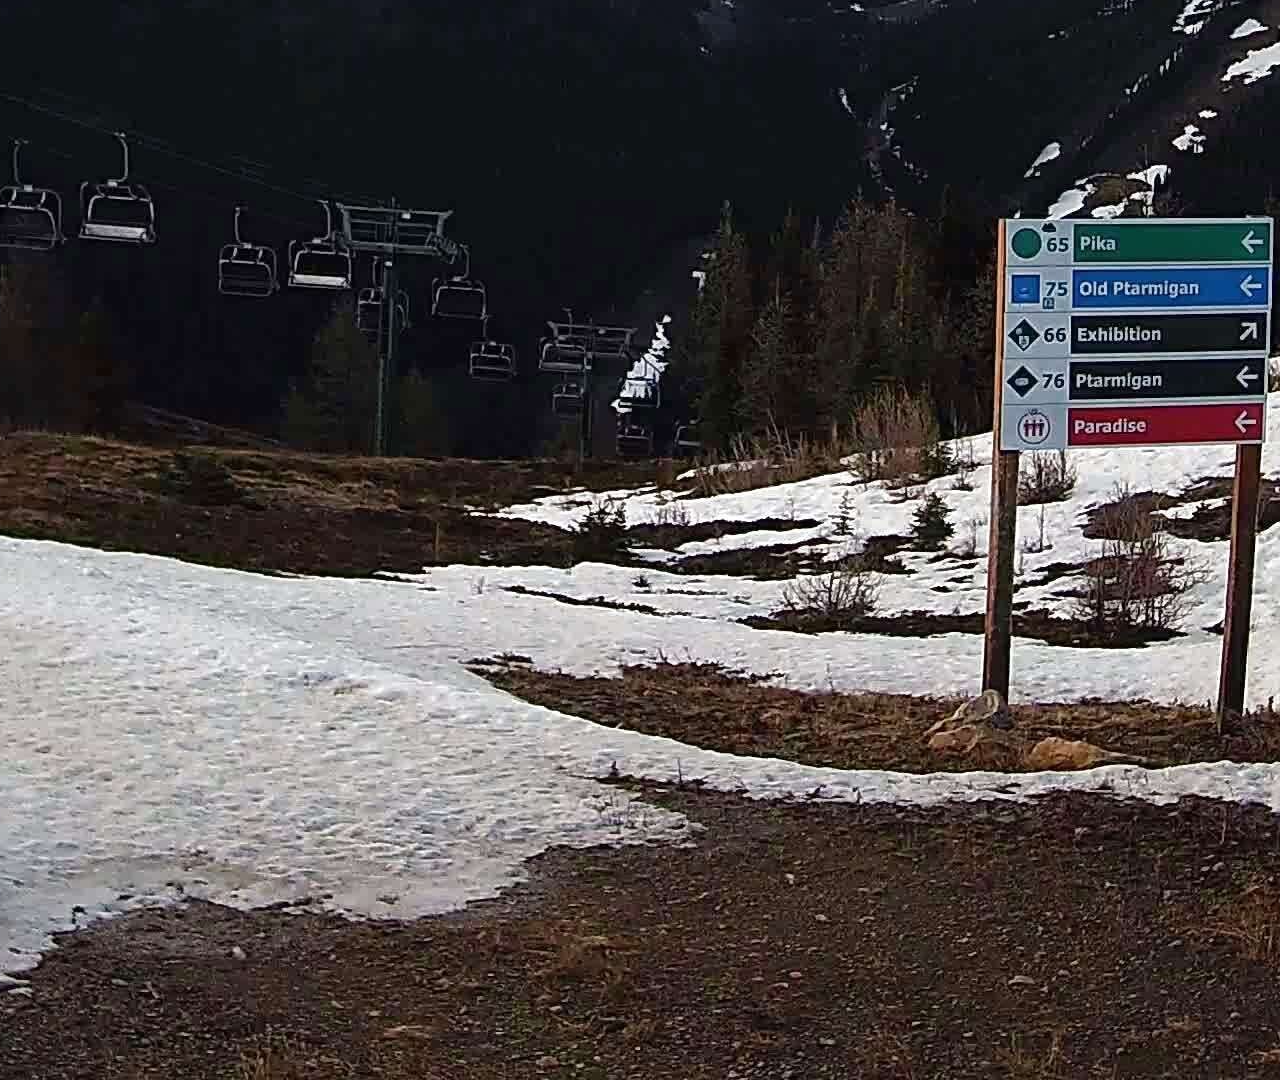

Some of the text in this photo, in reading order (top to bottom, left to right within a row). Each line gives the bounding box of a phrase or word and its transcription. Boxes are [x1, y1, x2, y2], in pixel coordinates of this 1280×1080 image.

[1046, 235, 1116, 253] 65 Pika
[1045, 280, 1199, 298] 75 Old Ptarmigan
[1043, 326, 1161, 343] 66 Exhibition
[1042, 372, 1162, 389] 76 Ptarmigan
[1074, 418, 1147, 434] Paradise
